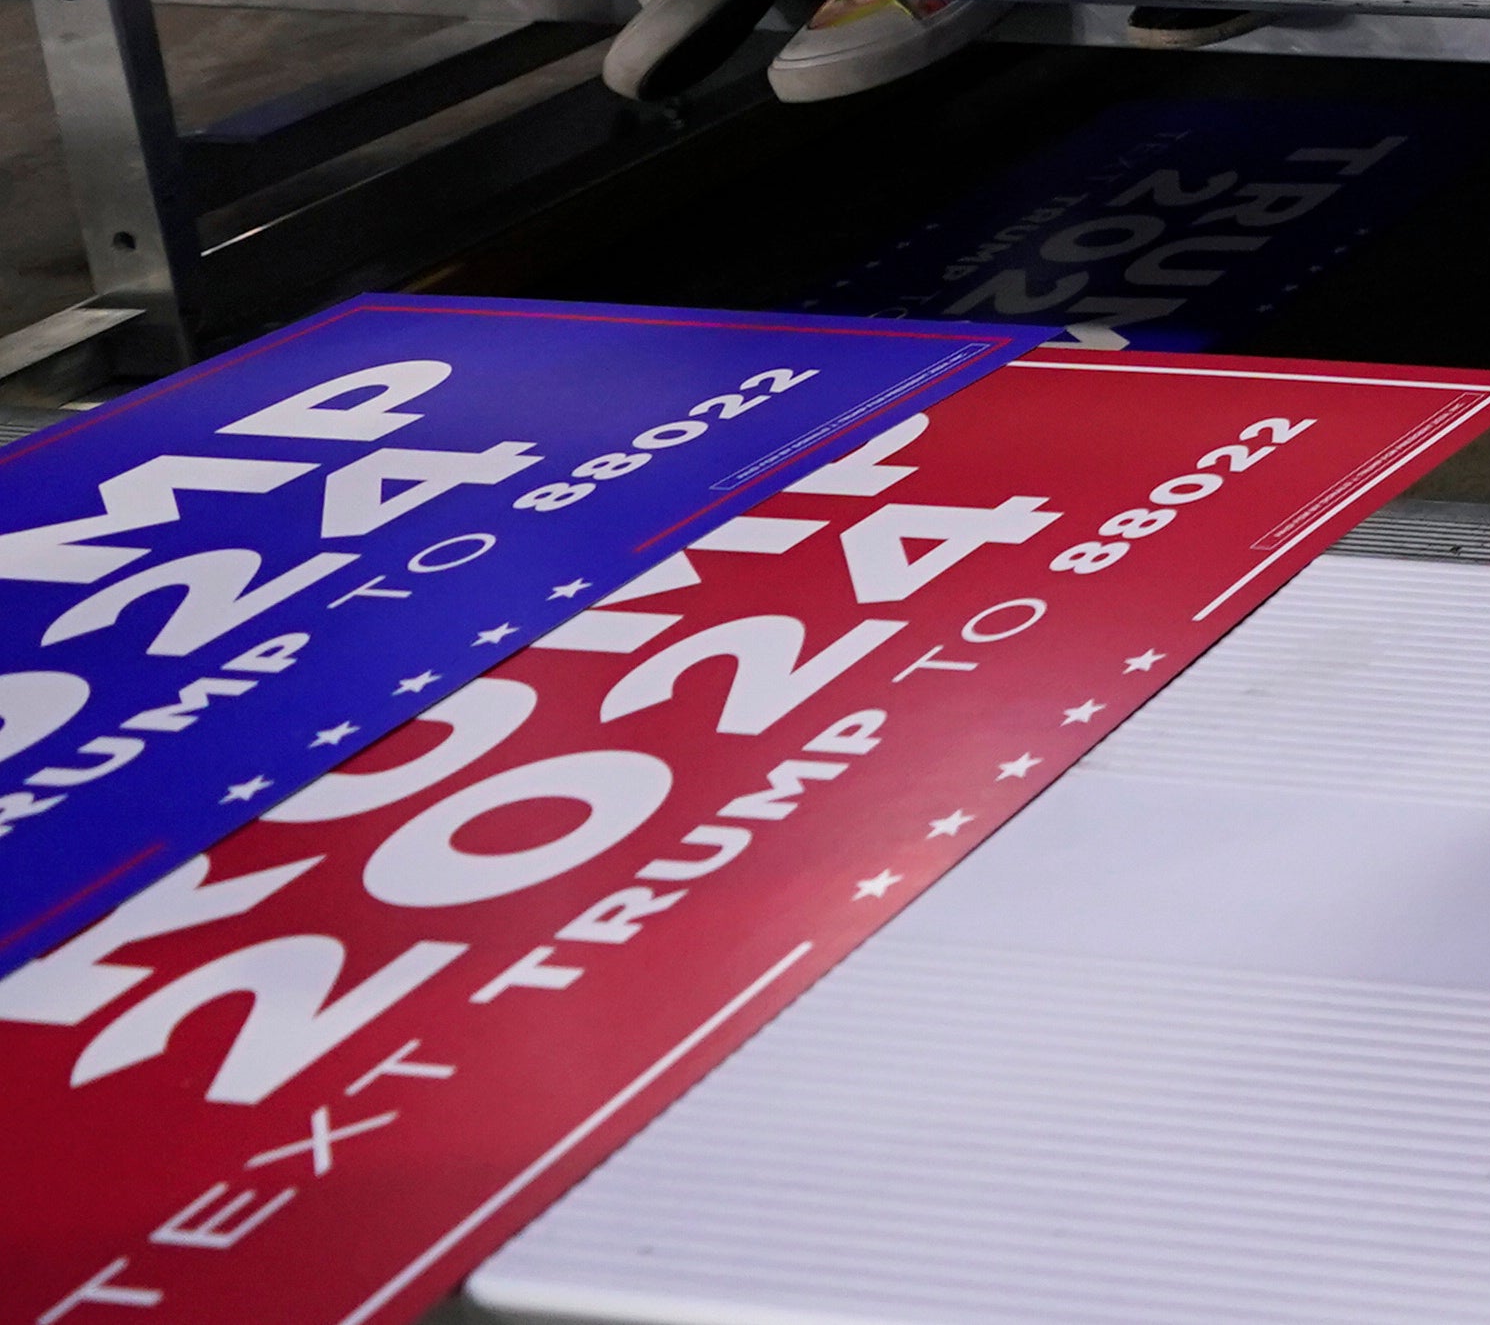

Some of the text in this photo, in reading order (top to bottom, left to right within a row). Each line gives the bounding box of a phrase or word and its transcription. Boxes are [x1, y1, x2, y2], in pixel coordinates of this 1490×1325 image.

[941, 169, 1239, 316] 202
[1038, 135, 1409, 350] TRUM
[328, 533, 497, 610] TO
[513, 367, 820, 513] 88022
[35, 1039, 457, 1324] TEXT
[469, 708, 888, 1004] TRUMP
[892, 597, 1048, 683] TO
[1049, 416, 1318, 575] 88022
[70, 495, 1065, 1105] 2024
